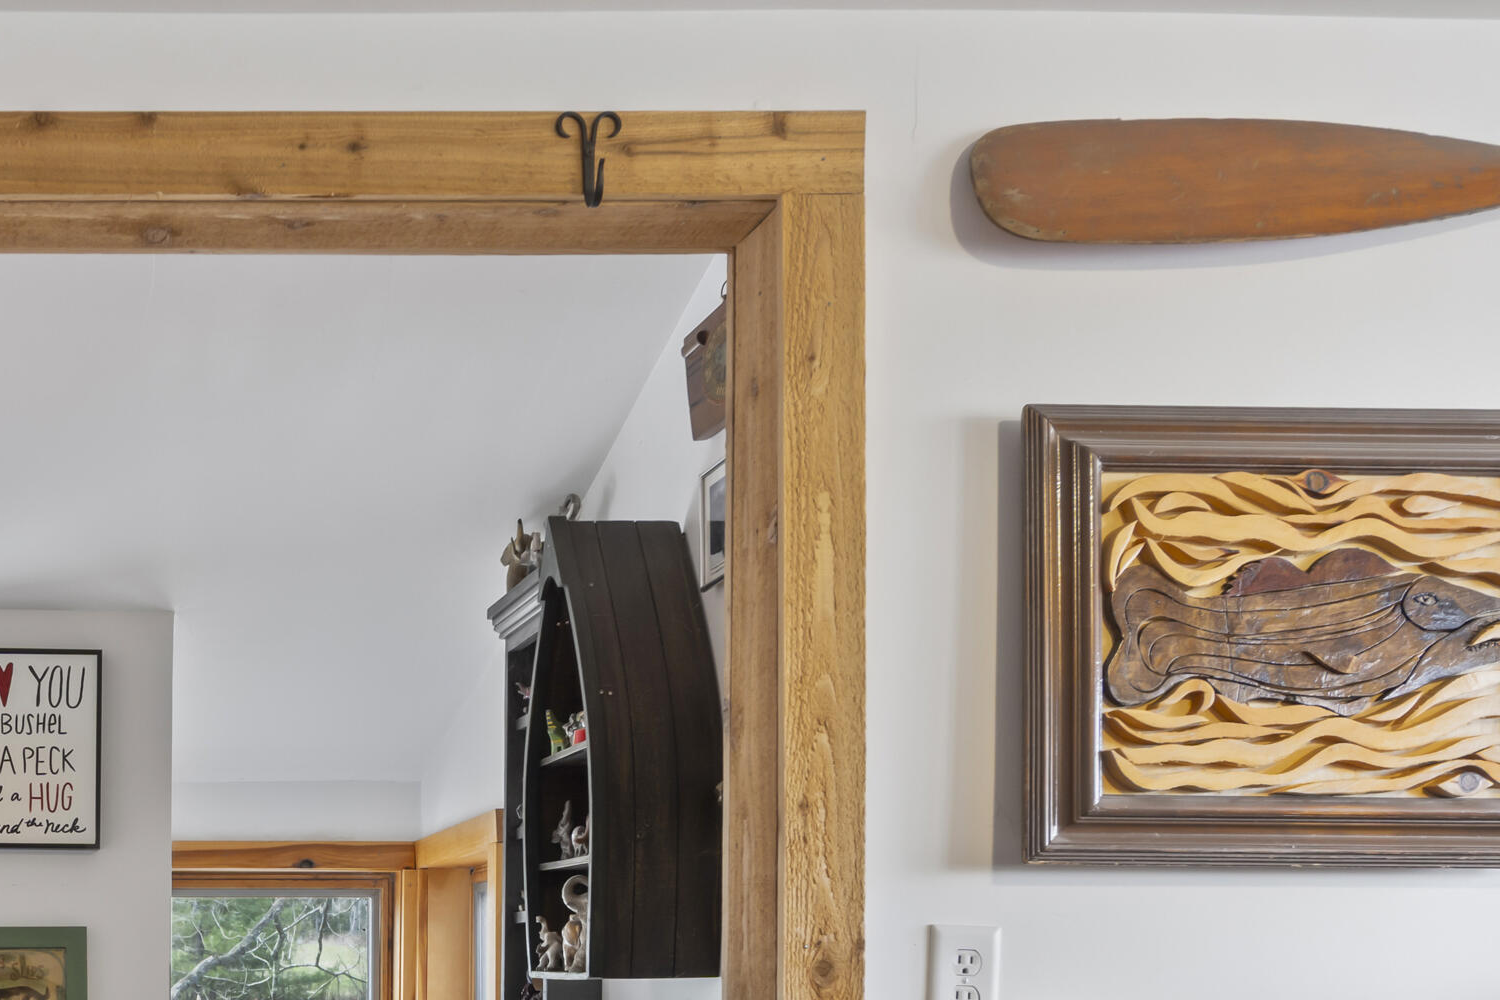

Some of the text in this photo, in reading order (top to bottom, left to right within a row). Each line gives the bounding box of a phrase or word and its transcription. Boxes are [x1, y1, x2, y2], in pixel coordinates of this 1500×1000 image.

[28, 665, 86, 709] YOU
[0, 745, 16, 775] A
[22, 746, 76, 775] PECK
[11, 792, 22, 802] a
[29, 782, 74, 813] HUG
[26, 817, 44, 828] the
[44, 817, 86, 835] neck
